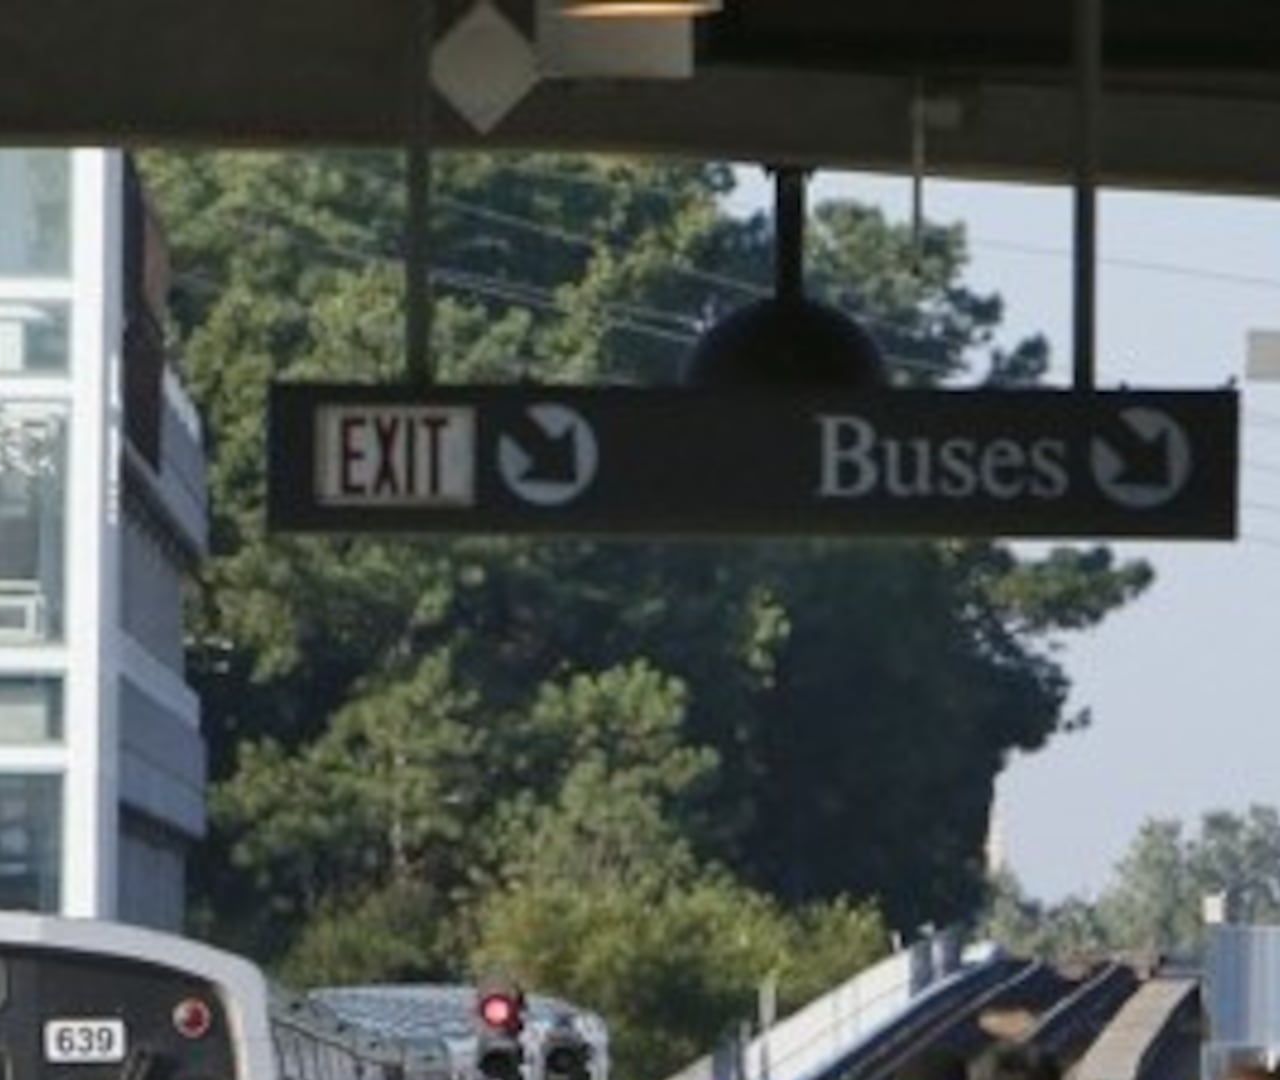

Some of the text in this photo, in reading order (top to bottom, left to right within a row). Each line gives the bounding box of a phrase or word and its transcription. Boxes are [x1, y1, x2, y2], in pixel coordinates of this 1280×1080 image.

[341, 413, 1070, 498] EXIT Buses
[56, 1026, 114, 1053] 639
